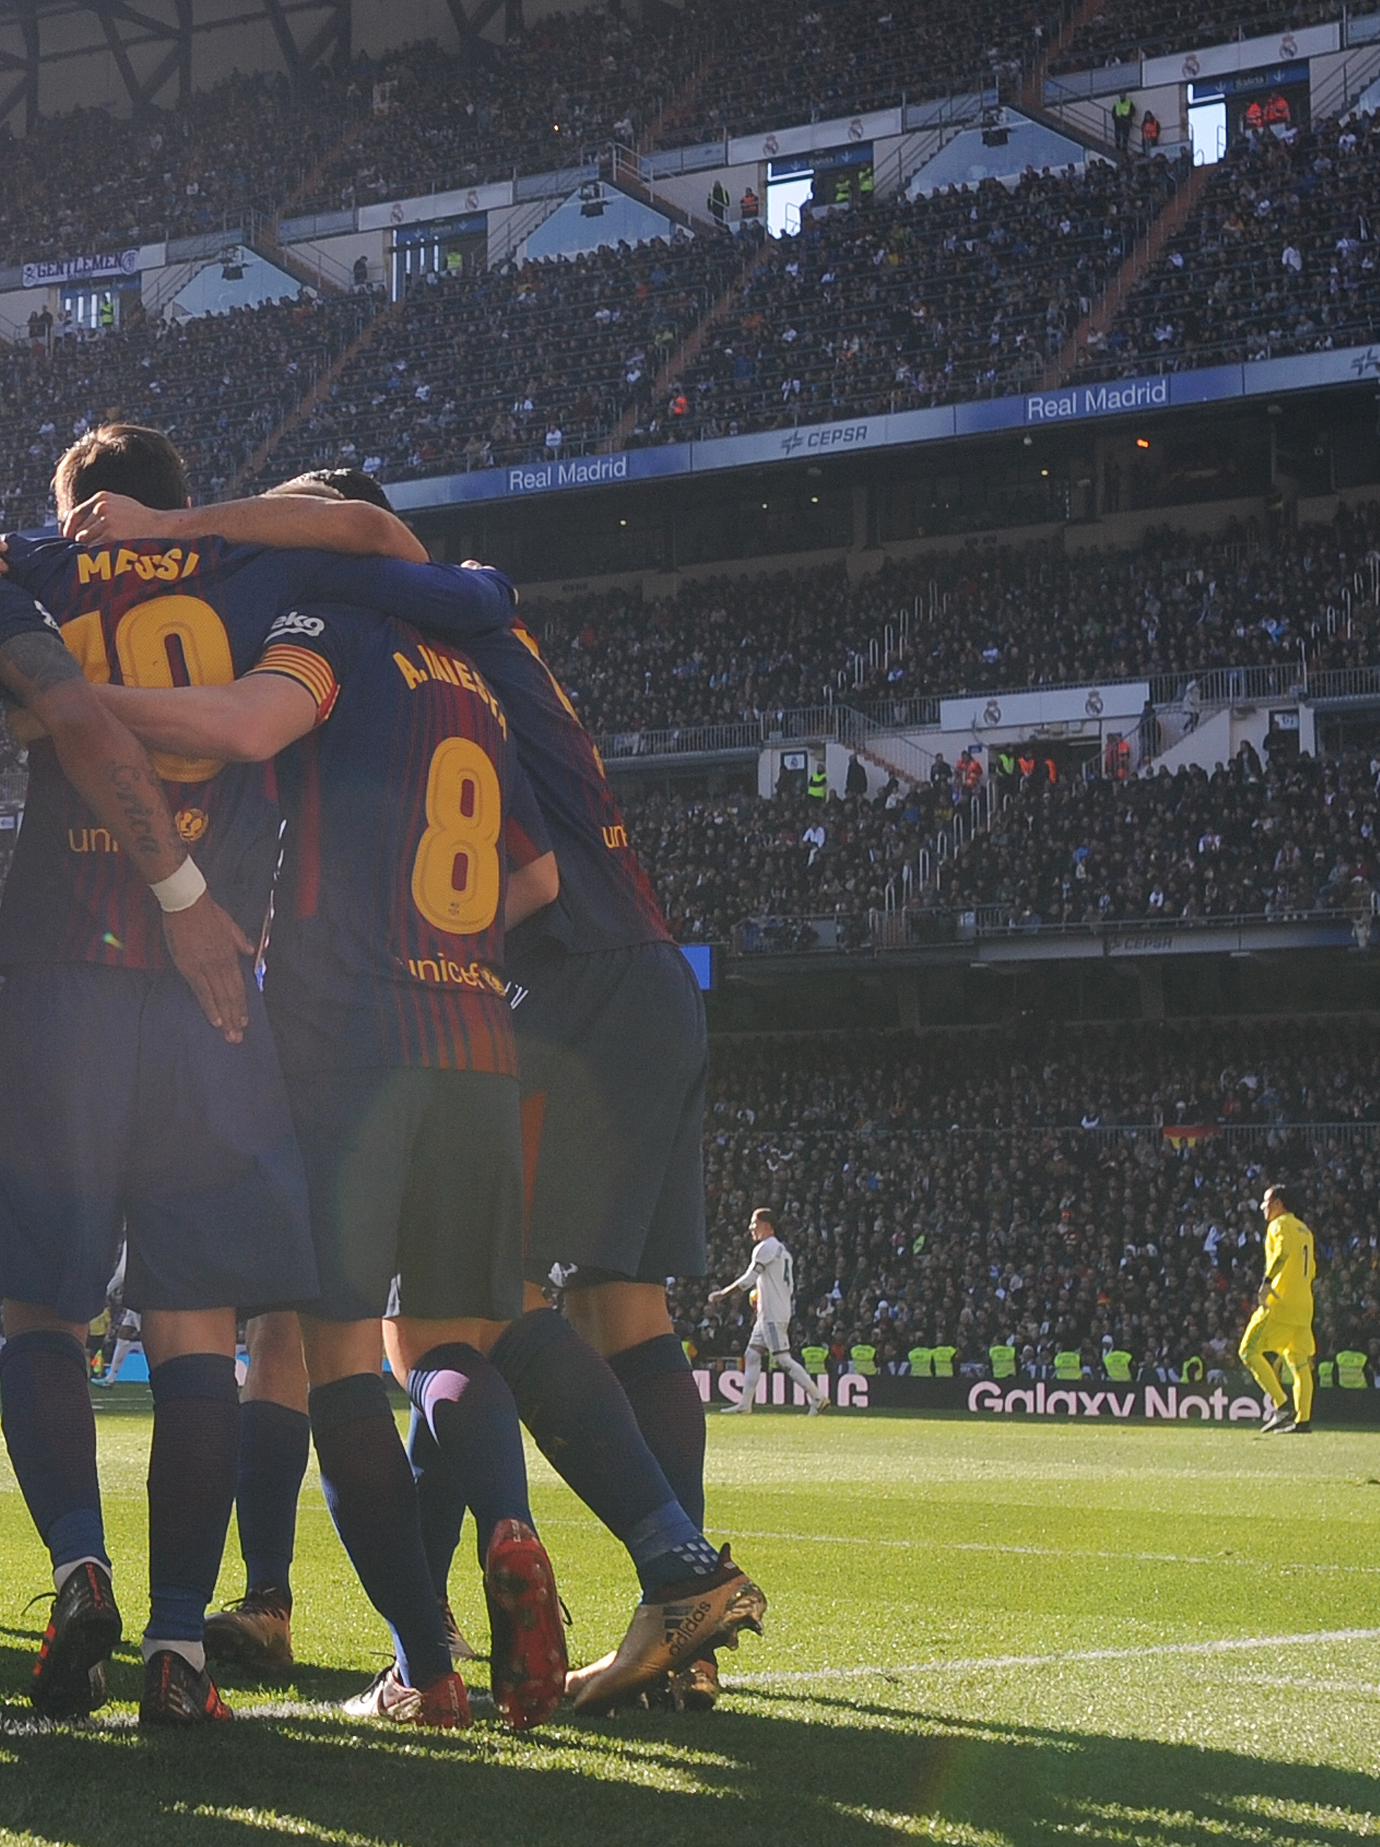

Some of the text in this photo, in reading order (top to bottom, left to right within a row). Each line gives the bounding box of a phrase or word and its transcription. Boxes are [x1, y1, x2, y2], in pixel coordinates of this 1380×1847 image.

[37, 252, 119, 277] GENTLEMEN
[1028, 381, 1167, 422] Real Madrid
[807, 426, 867, 448] CEPSA
[510, 457, 627, 490] Real Madrid
[77, 548, 200, 584] MESSI
[411, 736, 501, 934] 8
[782, 1258, 791, 1288] 4
[1302, 1244, 1309, 1279] 1
[968, 1380, 1135, 1417] Galaxy
[669, 1601, 712, 1656] adidas
